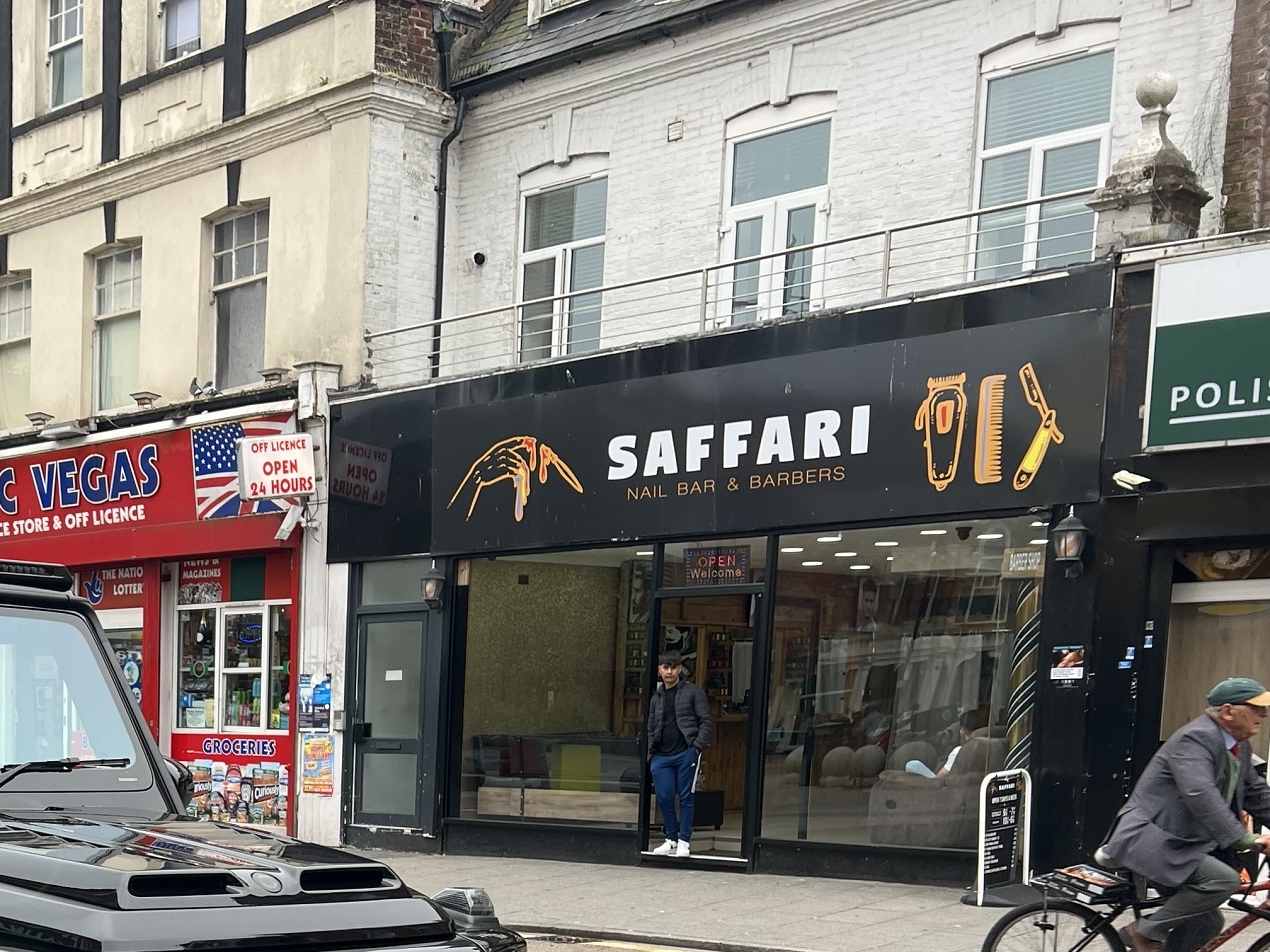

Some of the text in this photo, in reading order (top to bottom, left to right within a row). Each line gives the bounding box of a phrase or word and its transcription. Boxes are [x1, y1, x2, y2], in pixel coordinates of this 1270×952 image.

[1170, 377, 1270, 412] POLI
[251, 439, 306, 453] OFF LICENCE
[608, 405, 870, 480] SAFFARI
[263, 459, 298, 476] OPEN
[30, 444, 160, 511] VEGAS
[251, 476, 313, 496] 24 HOURS
[627, 466, 846, 500] NAIL BAR & BARBERS
[12, 516, 50, 535] STORE
[53, 515, 62, 529] &
[65, 511, 89, 529] OFF
[93, 504, 145, 526] LICENCE
[698, 555, 736, 568] OPEN
[102, 569, 116, 580] THE
[182, 568, 221, 579] MAGAZINES
[690, 568, 742, 579] Welcome
[113, 582, 144, 596] LOTTER
[203, 738, 276, 757] GROCERIES
